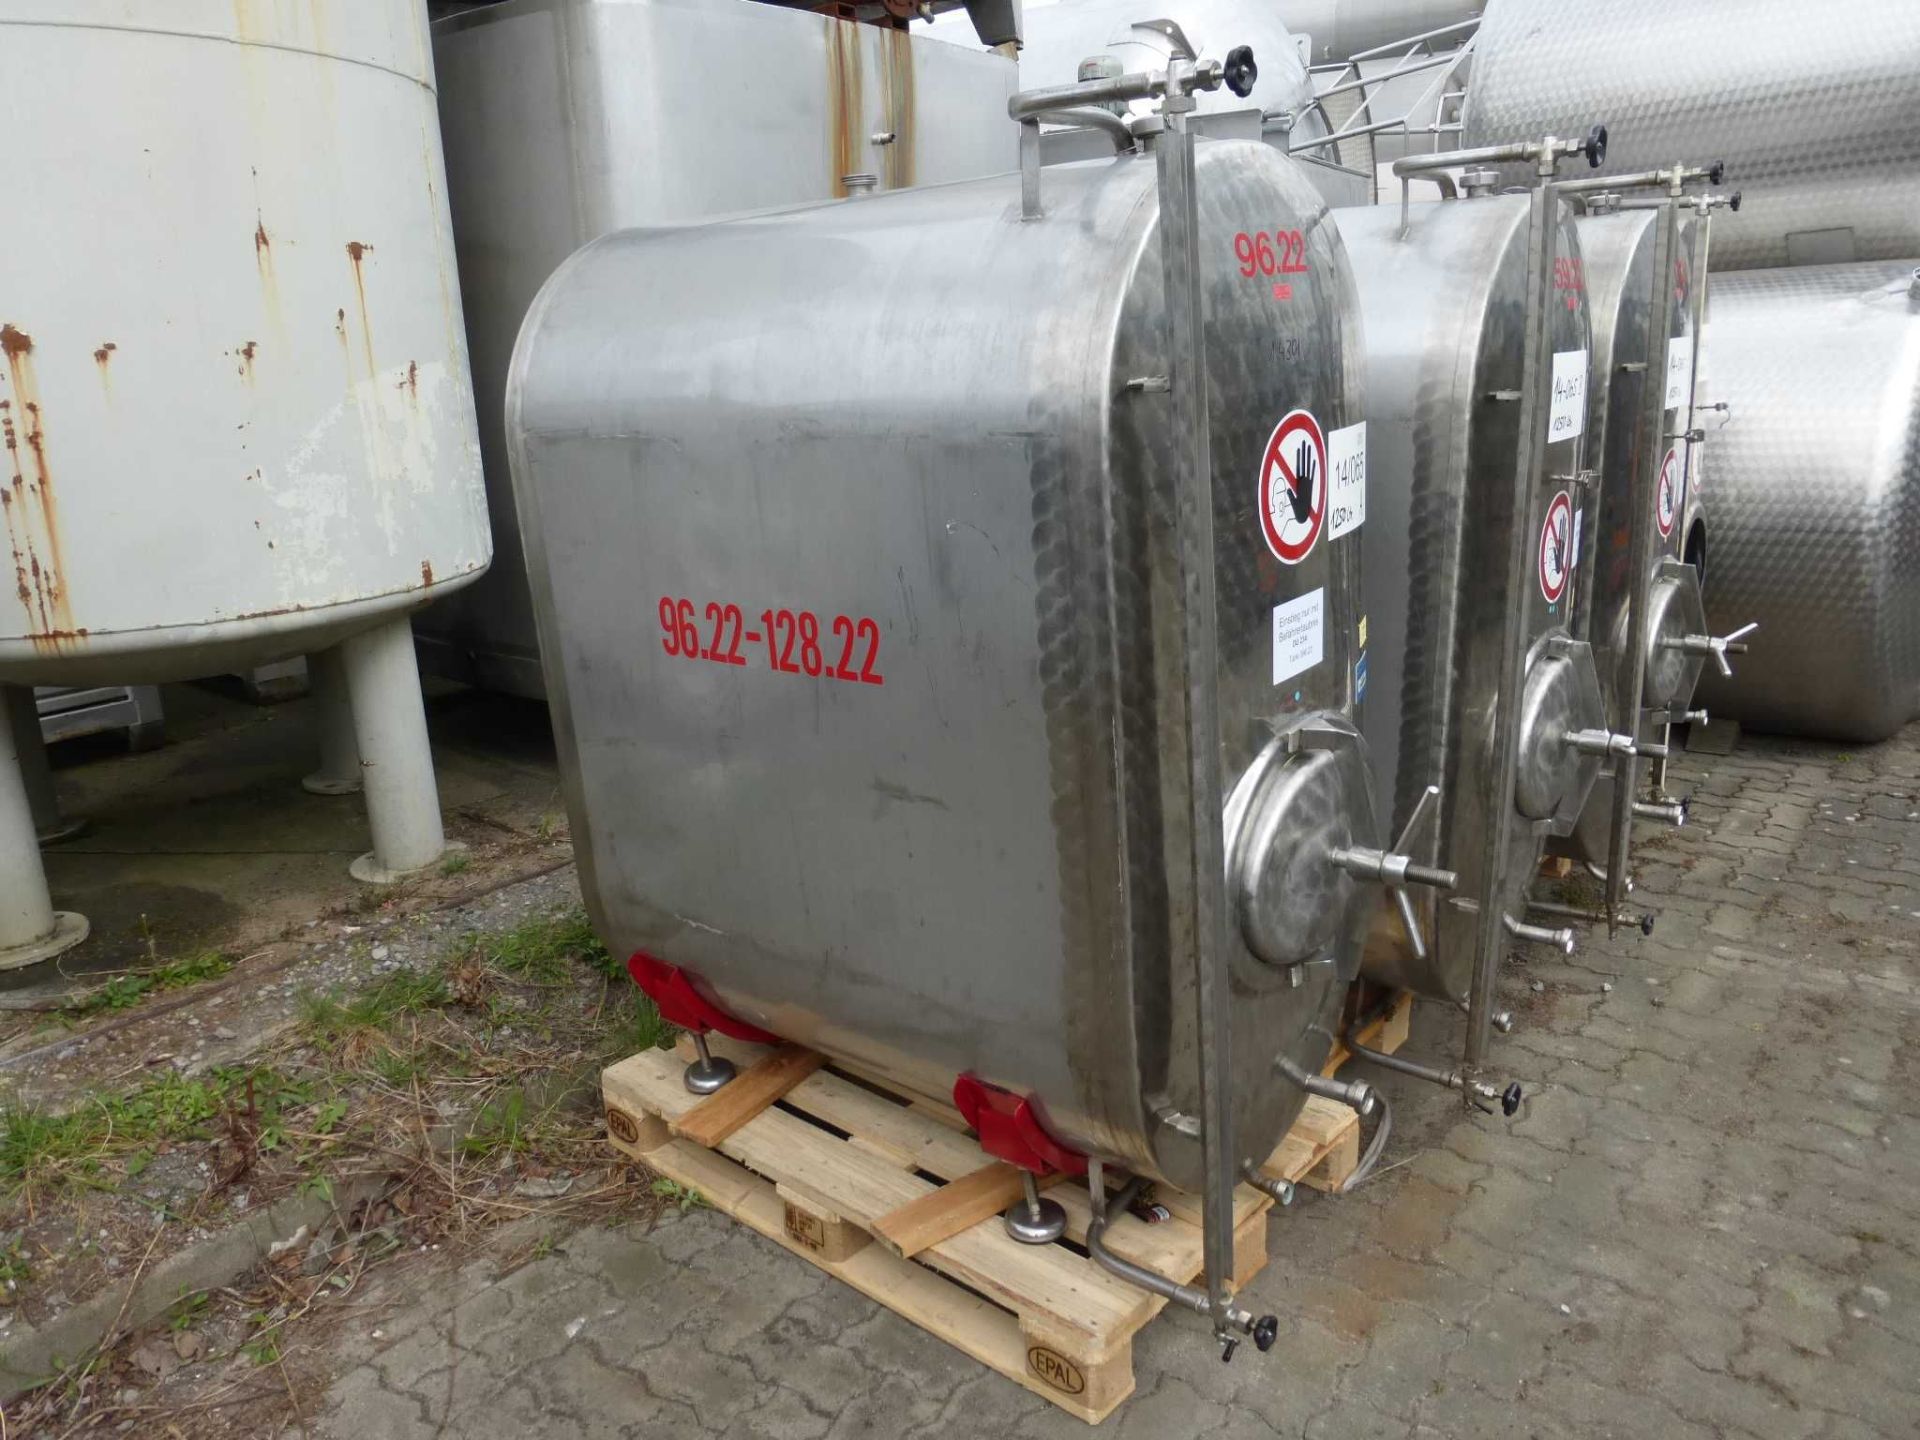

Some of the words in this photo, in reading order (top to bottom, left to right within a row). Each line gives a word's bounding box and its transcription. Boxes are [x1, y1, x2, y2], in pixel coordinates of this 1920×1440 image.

[1233, 229, 1309, 278] 96.22
[658, 596, 884, 685] 96.22-128.22
[611, 1111, 635, 1140] EPAL
[1035, 1351, 1078, 1391] EPAL
